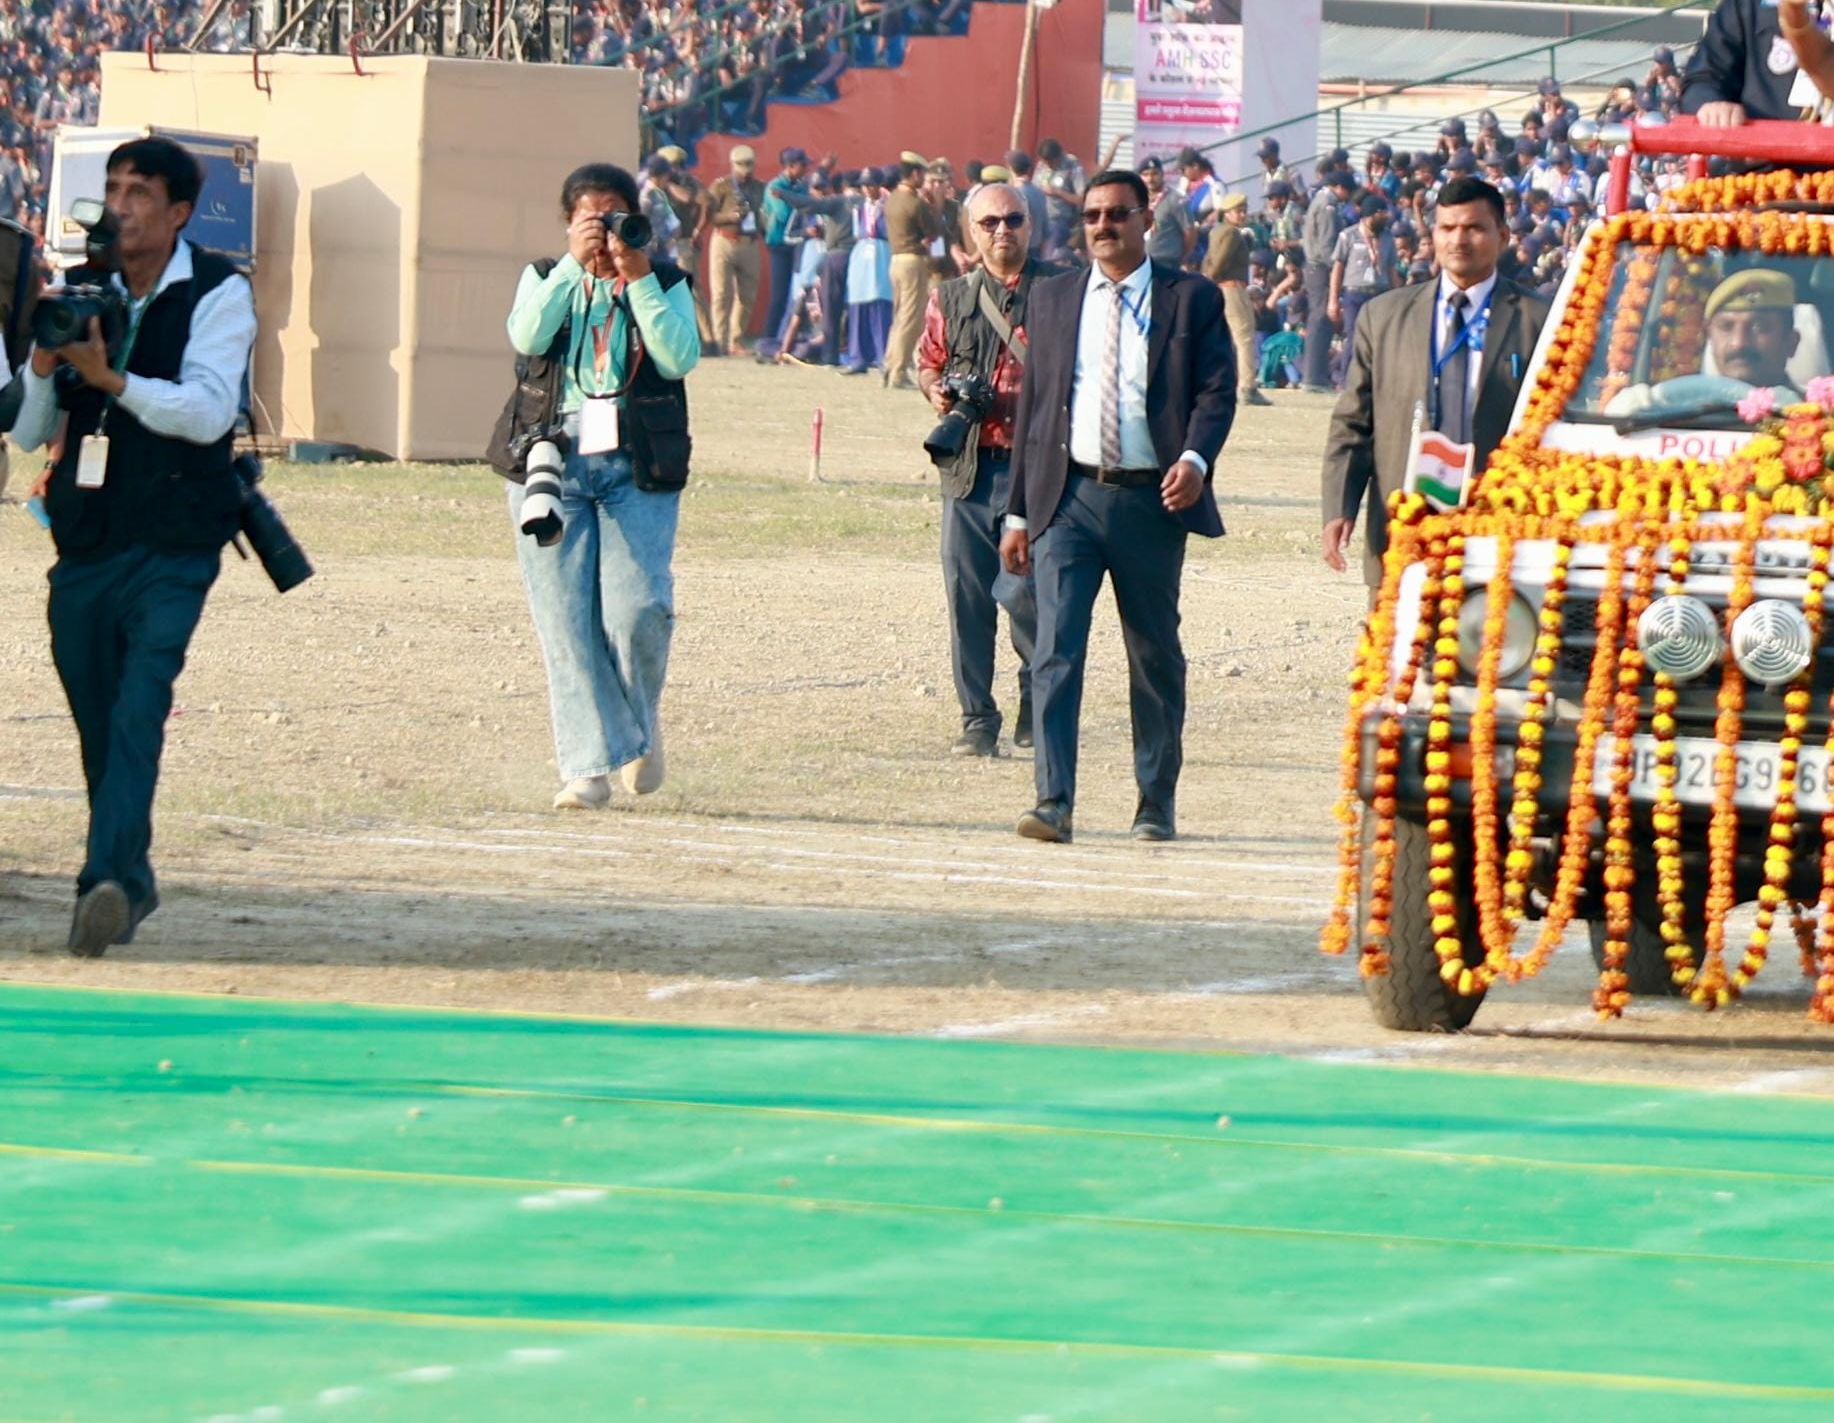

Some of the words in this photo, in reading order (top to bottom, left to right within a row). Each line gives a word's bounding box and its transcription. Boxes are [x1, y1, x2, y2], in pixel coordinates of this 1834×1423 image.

[1155, 49, 1193, 68] AMH
[1199, 50, 1232, 70] SSC
[1658, 433, 1739, 460] POLI
